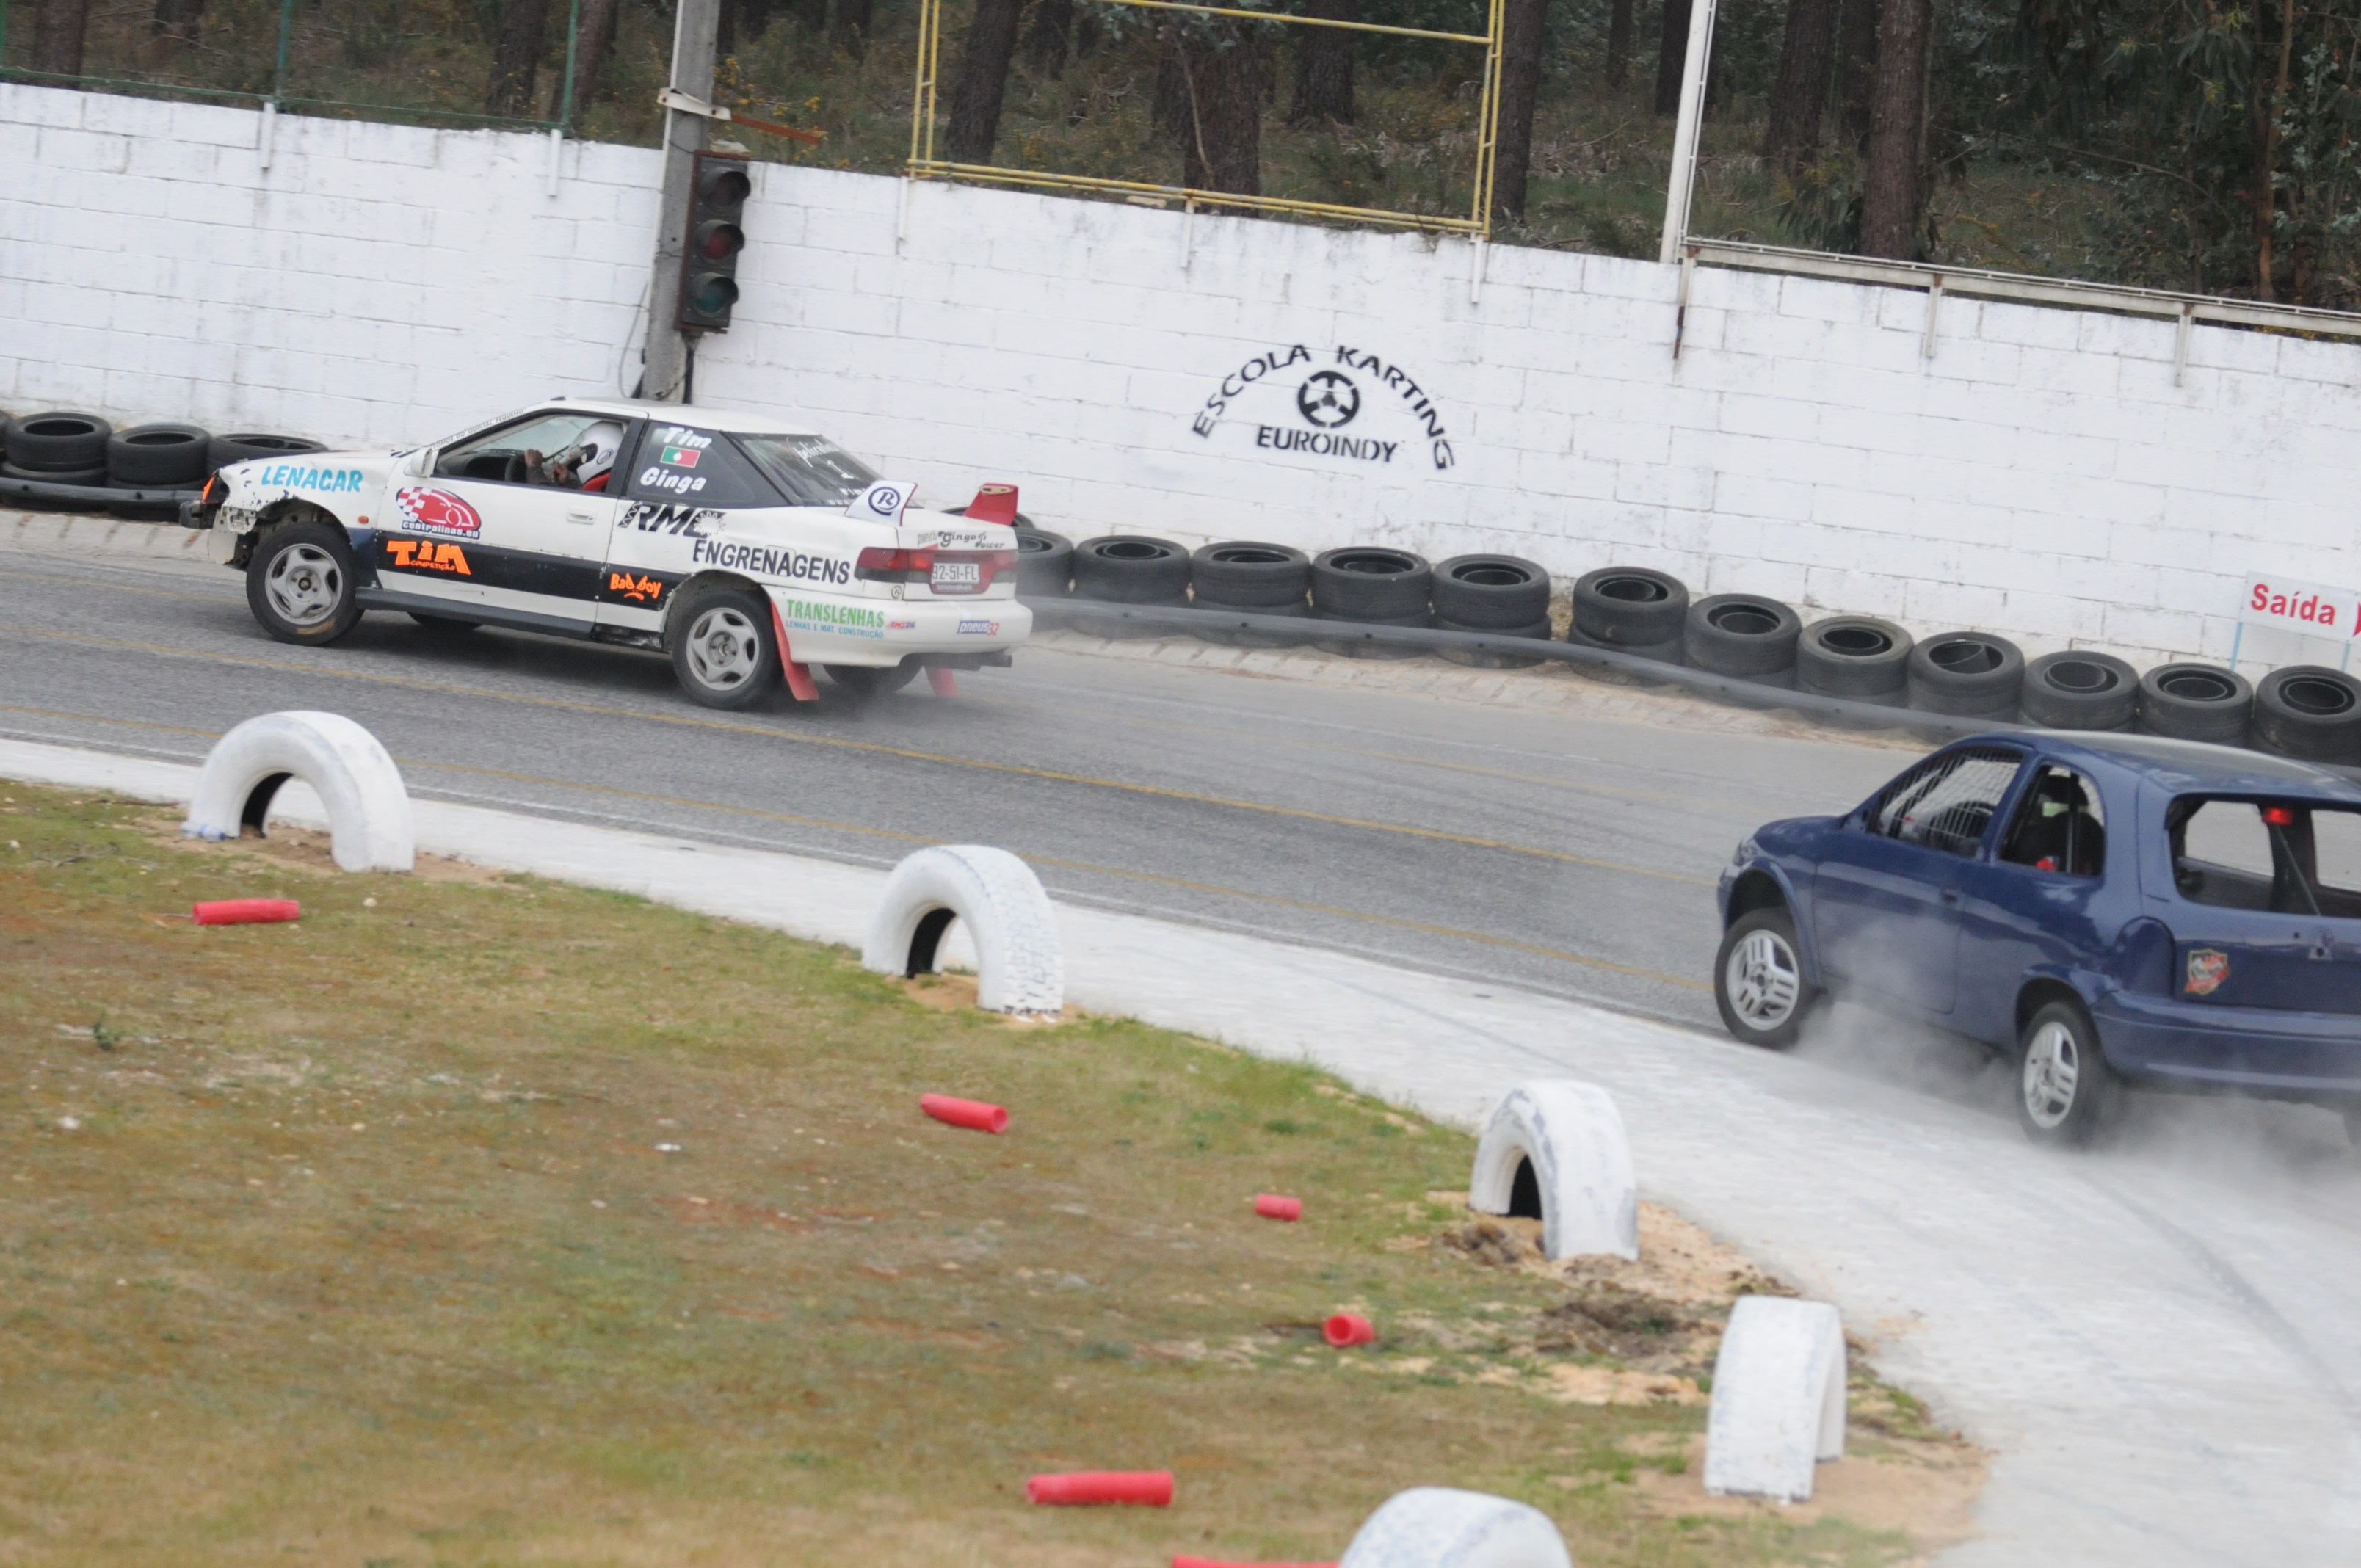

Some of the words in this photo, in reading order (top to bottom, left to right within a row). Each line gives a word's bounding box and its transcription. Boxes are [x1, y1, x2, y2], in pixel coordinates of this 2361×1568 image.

[1192, 344, 1311, 439] ESCOLA
[1336, 345, 1455, 470] KARTING
[663, 427, 712, 449] Tim
[1256, 424, 1398, 463] EUROINDY
[261, 465, 363, 493] LENACAR
[640, 467, 707, 494] Ginga
[402, 520, 479, 537] centralinas.eu
[692, 538, 851, 585] ENGRENAGENS
[610, 573, 635, 590] Bad
[787, 598, 885, 628] TRANSLENHAS
[2251, 584, 2336, 625] Saída
[786, 620, 811, 631] LENHAS
[813, 623, 818, 631] E
[838, 626, 885, 639] CONSTRUÇÃO
